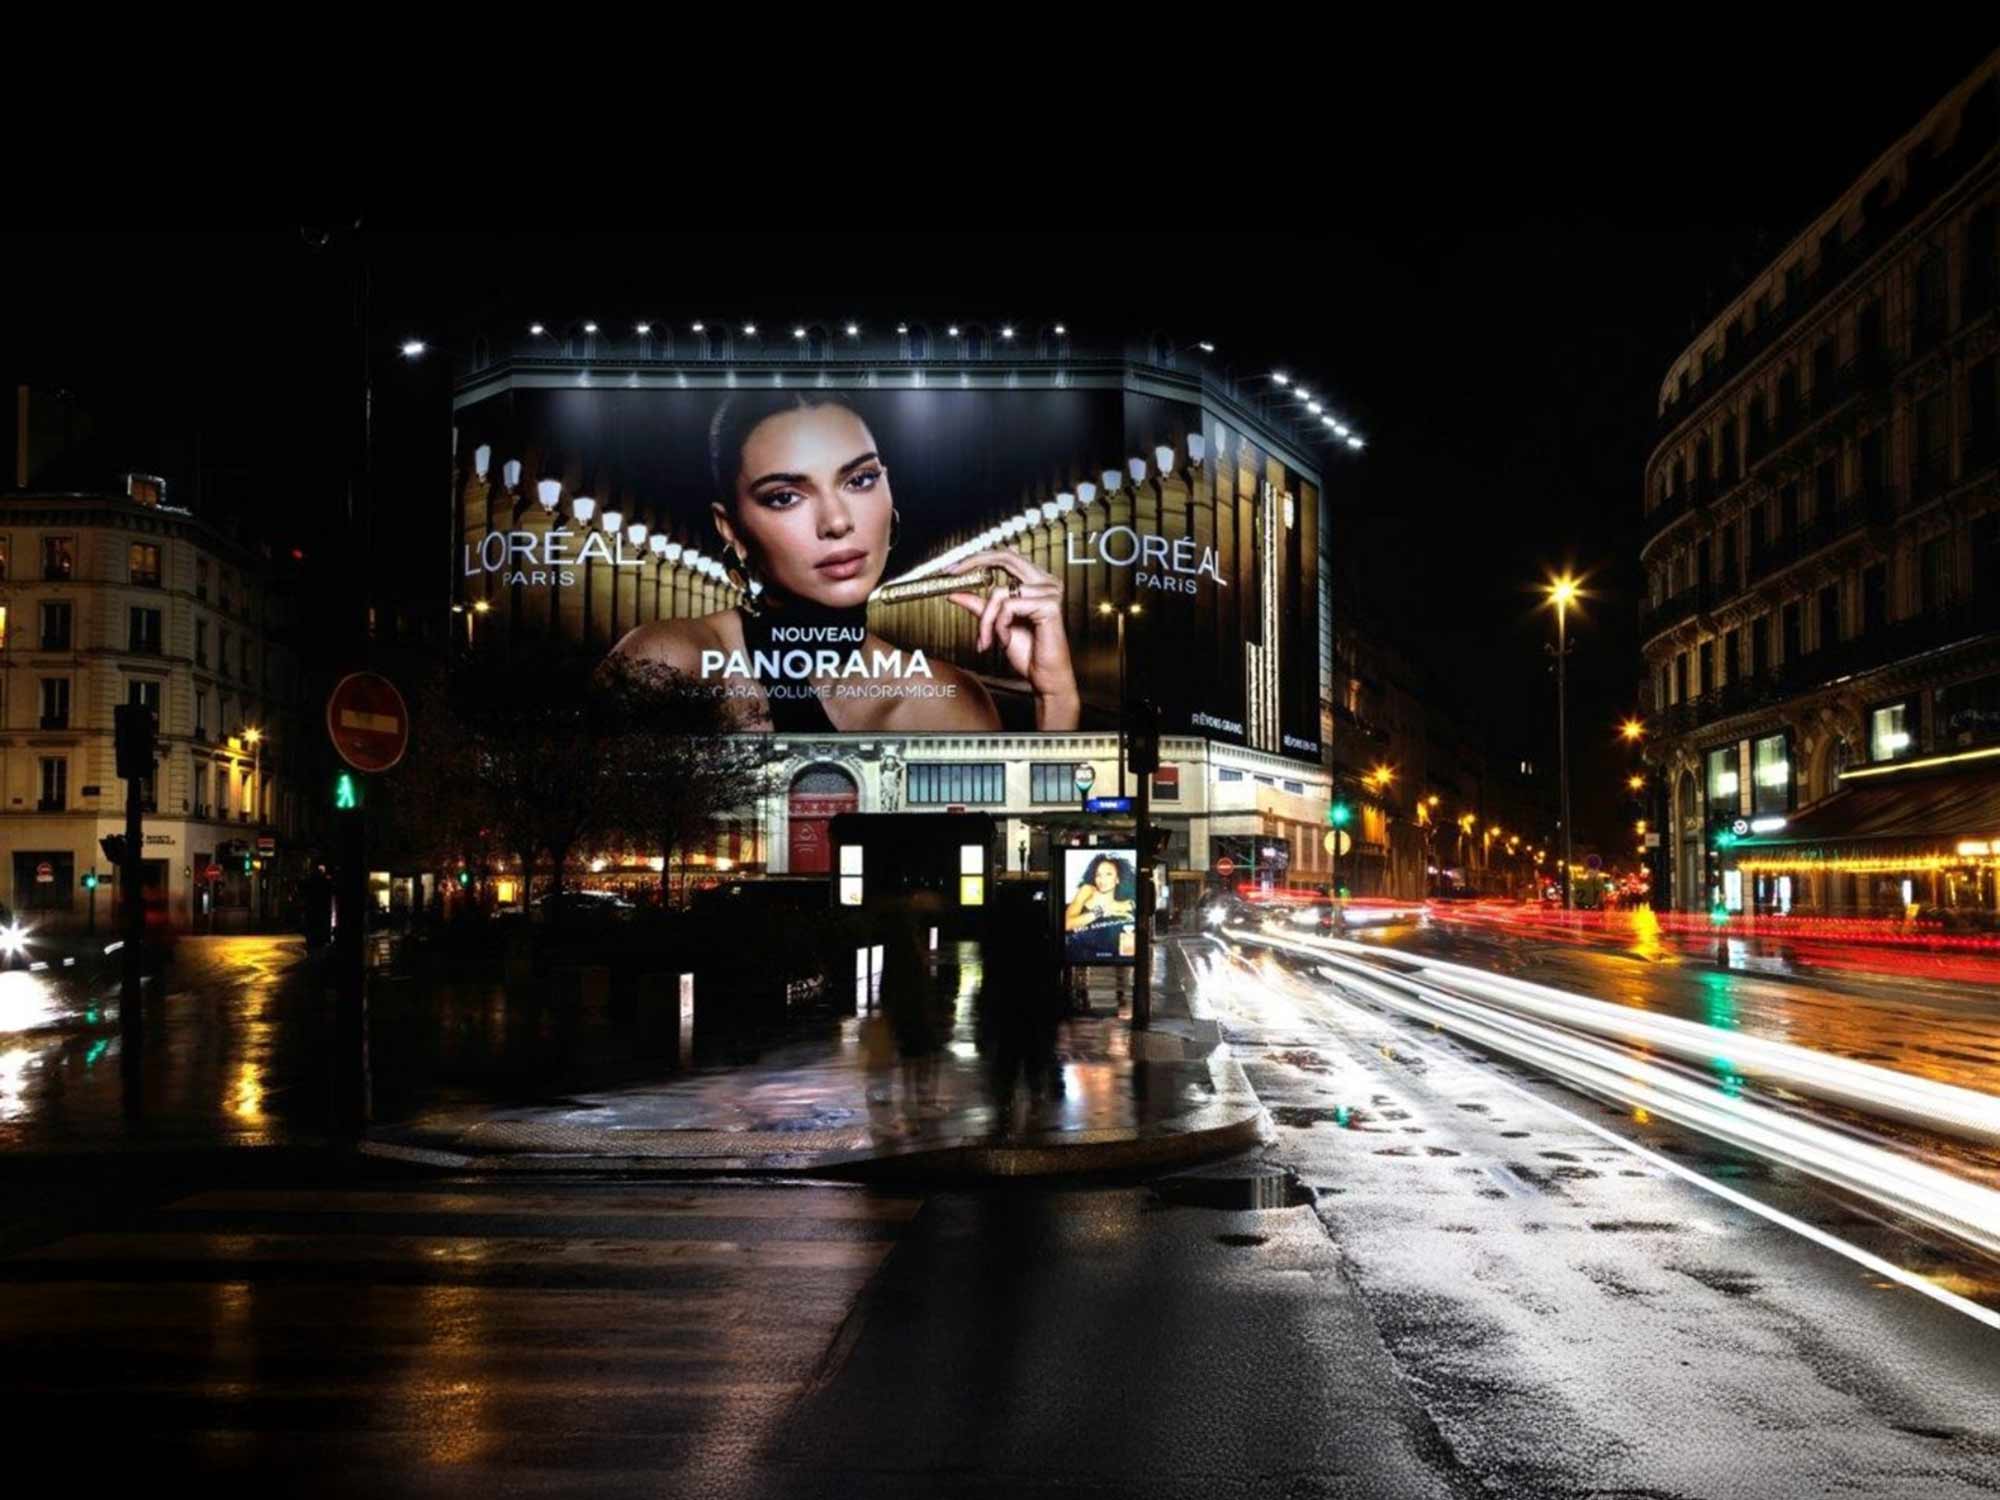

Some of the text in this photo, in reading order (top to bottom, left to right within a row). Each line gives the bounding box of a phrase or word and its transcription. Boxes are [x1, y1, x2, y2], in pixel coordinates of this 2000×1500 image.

[464, 526, 646, 577] L'ORÉAL
[1066, 525, 1228, 586] L'ORÉAL
[771, 627, 865, 642] NOUVEAU
[701, 649, 933, 679] PANORAMA
[764, 685, 831, 698] VOLUME
[836, 685, 957, 698] PANORAMIQUE
